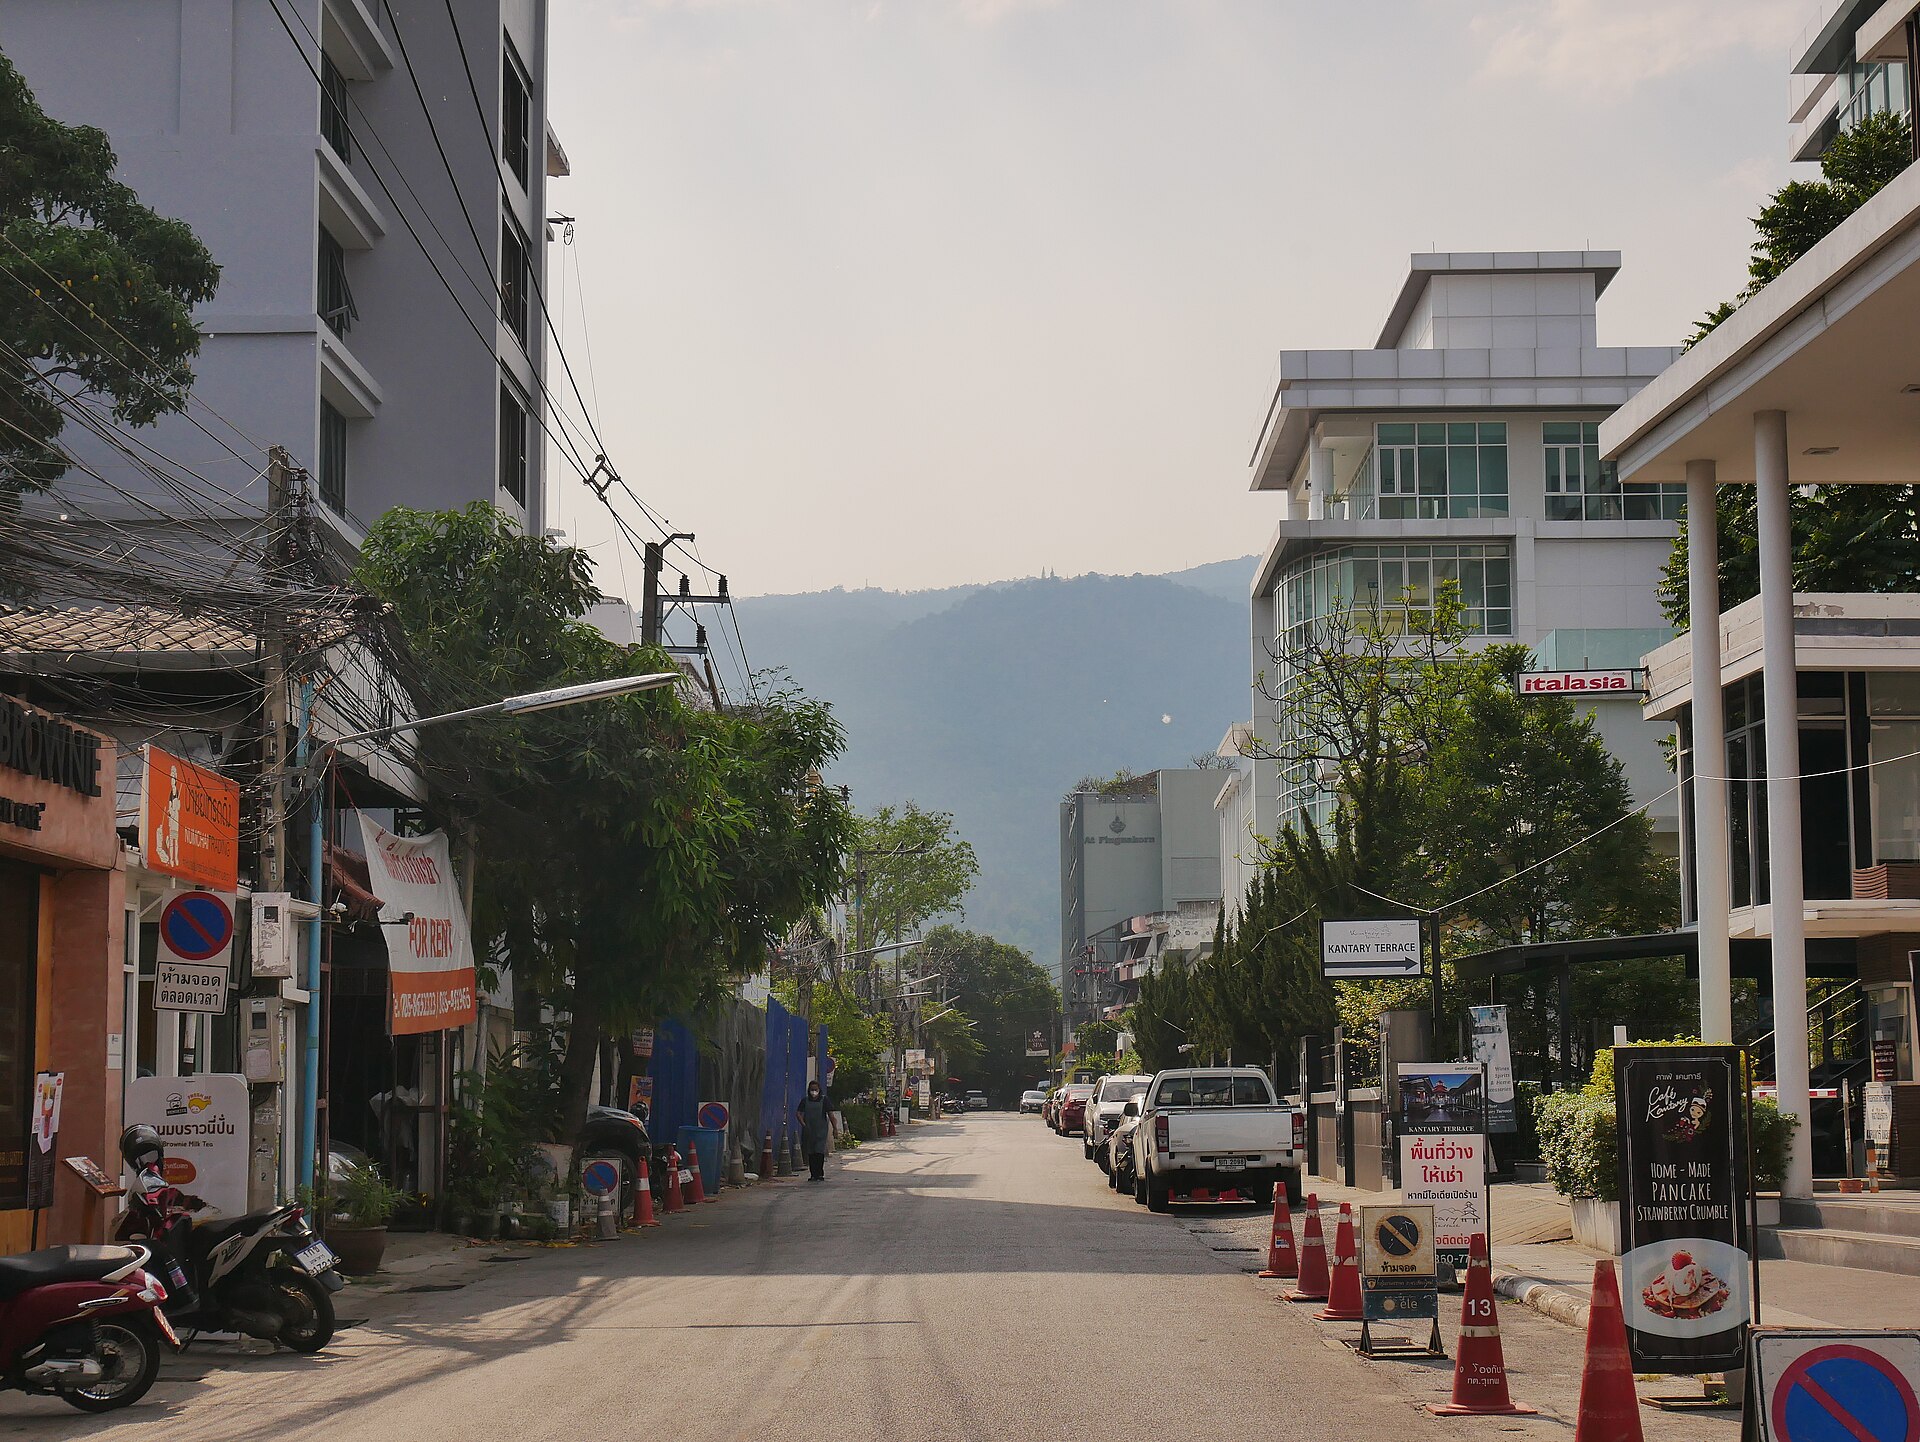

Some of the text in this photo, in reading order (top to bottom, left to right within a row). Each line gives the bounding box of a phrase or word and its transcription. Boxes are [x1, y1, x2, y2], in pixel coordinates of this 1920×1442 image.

[1525, 674, 1627, 692] italasia
[409, 917, 453, 959] FOR RENT
[1327, 942, 1416, 955] KANTARY TERRACE
[161, 966, 221, 987] ห้ามจอด
[161, 990, 219, 1006] ตลอดเวลา
[151, 1114, 235, 1136] นมบราวนี่ปั่น
[1408, 1125, 1442, 1133] KANTARY
[1410, 1137, 1473, 1160] พื้นที่ว่าง
[1421, 1165, 1463, 1183] ให้เช่า
[1407, 1189, 1478, 1200] หากมีไอเดียเปิดร้าน
[1435, 1229, 1471, 1245] จติดต่อ
[1381, 1261, 1417, 1273] ห้ามจอด
[1468, 1299, 1491, 1317] 13
